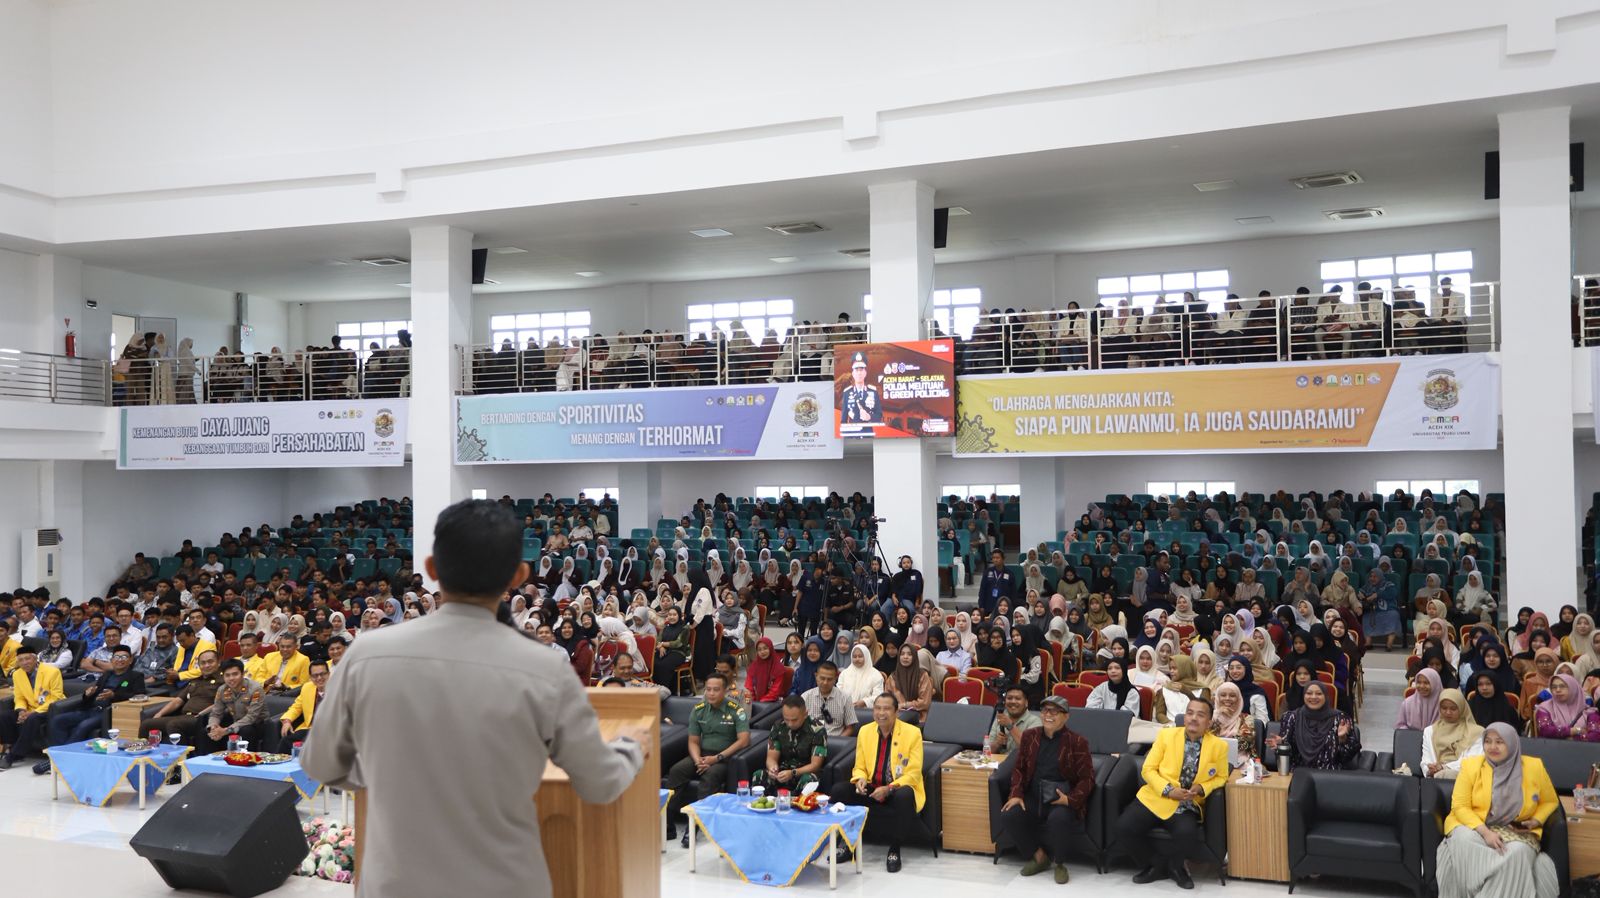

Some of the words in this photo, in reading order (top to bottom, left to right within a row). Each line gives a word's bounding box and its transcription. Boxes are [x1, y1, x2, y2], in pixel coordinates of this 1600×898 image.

[883, 382, 907, 391] POLDA
[908, 382, 944, 390] MEUTUAH
[890, 390, 914, 399] GREEN
[914, 389, 950, 398] POLICING
[1055, 392, 1140, 410] MENGAJARKAN
[1144, 392, 1175, 407] KITA:
[481, 412, 526, 425] BERTANDING
[526, 412, 556, 424] DENGAN
[559, 404, 644, 425] SPORTIVITAS
[1015, 416, 1058, 436] SIAPA
[1061, 415, 1091, 435] PUN
[1096, 413, 1180, 436] LAWANMU,
[1184, 412, 1200, 432] IA
[1204, 411, 1244, 432] JUGA
[132, 427, 175, 438] KEMENANGAN
[176, 426, 198, 438] BUTUH
[200, 418, 230, 437] DAYA
[232, 416, 270, 436] JUANG
[570, 432, 603, 445] MENANG
[604, 432, 636, 444] DENGAN
[638, 425, 724, 446] TERHORMAT
[184, 443, 225, 454] KEBANGGAAN
[226, 442, 253, 454] TUMBUH
[254, 442, 270, 453] DARI
[272, 432, 364, 452] PERSAHABATAN
